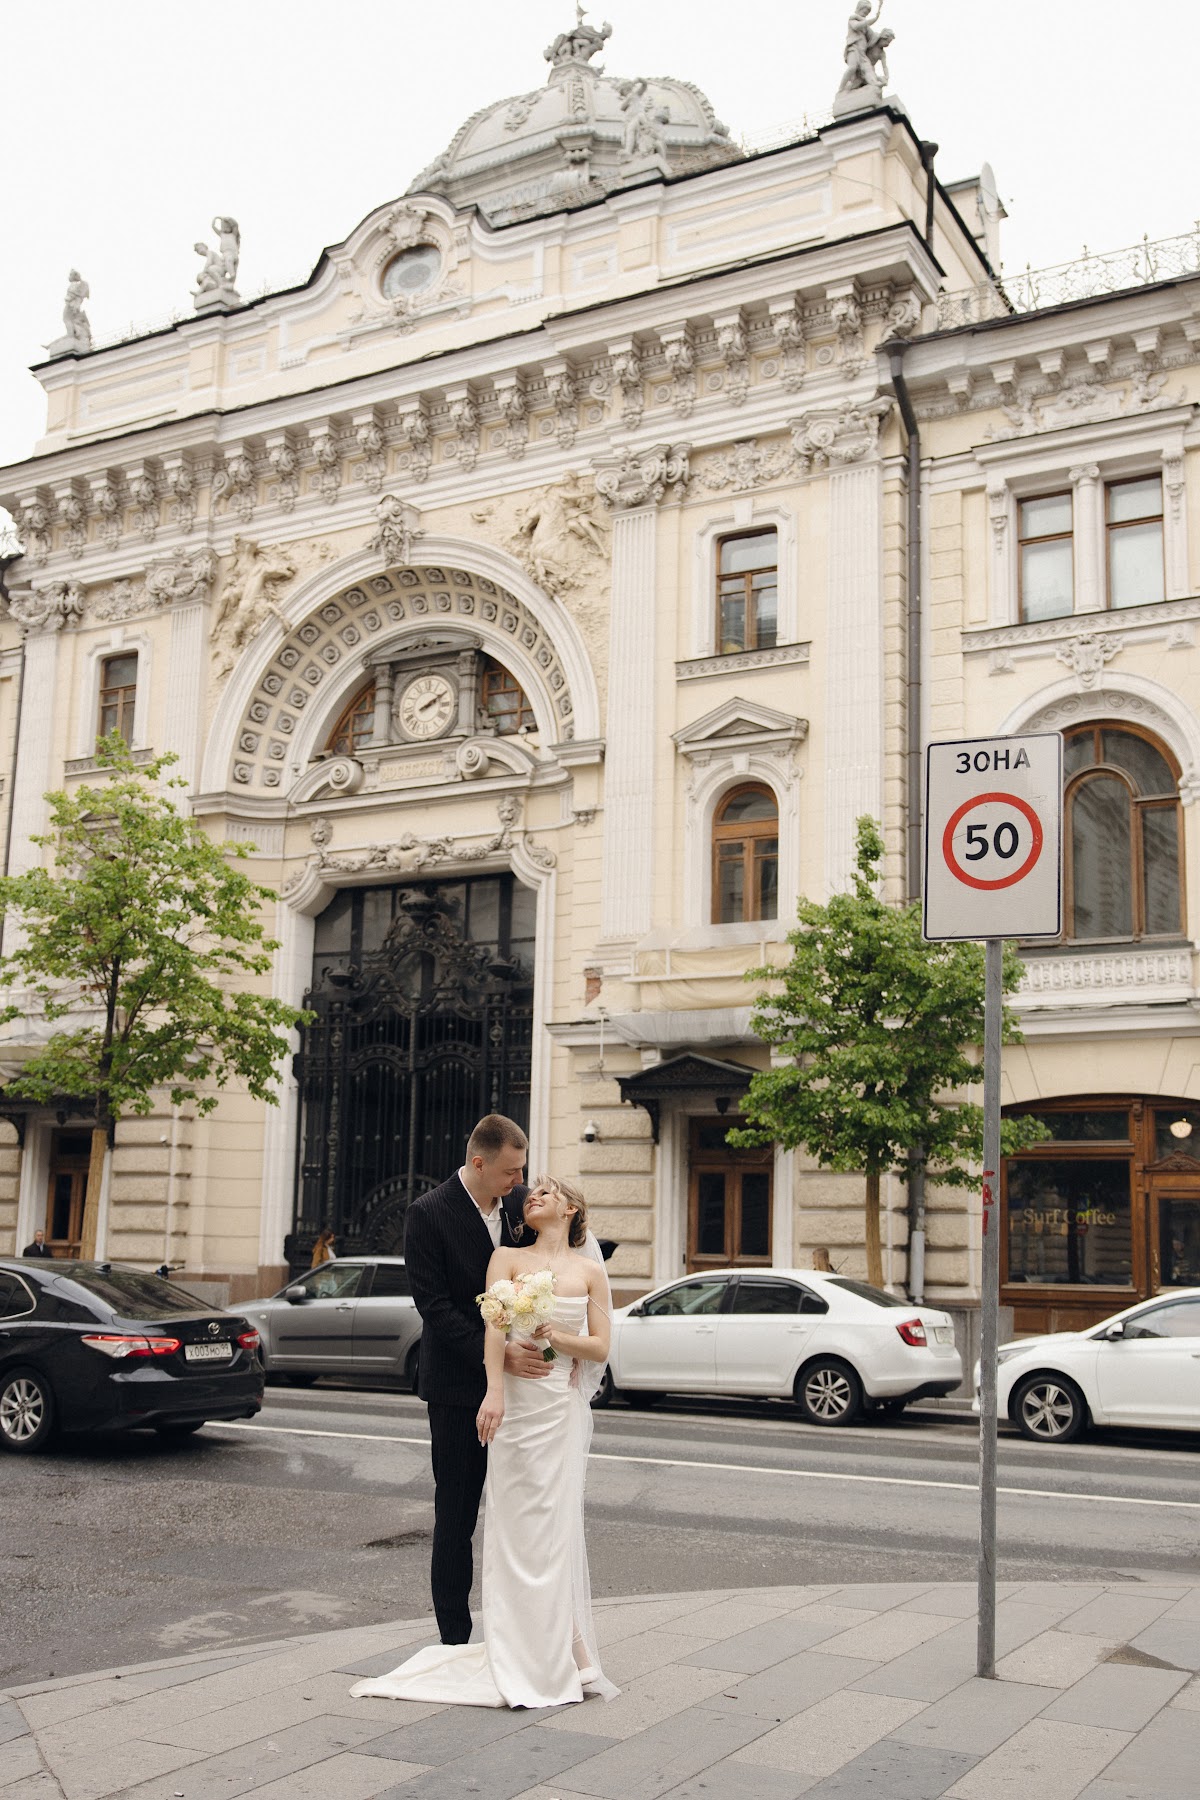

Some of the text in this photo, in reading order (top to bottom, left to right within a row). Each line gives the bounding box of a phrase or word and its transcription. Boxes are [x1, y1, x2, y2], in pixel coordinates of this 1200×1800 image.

[956, 748, 1031, 774] ЗОНА
[965, 821, 1019, 861] 50
[1023, 1208, 1116, 1225] Surf Coffee
